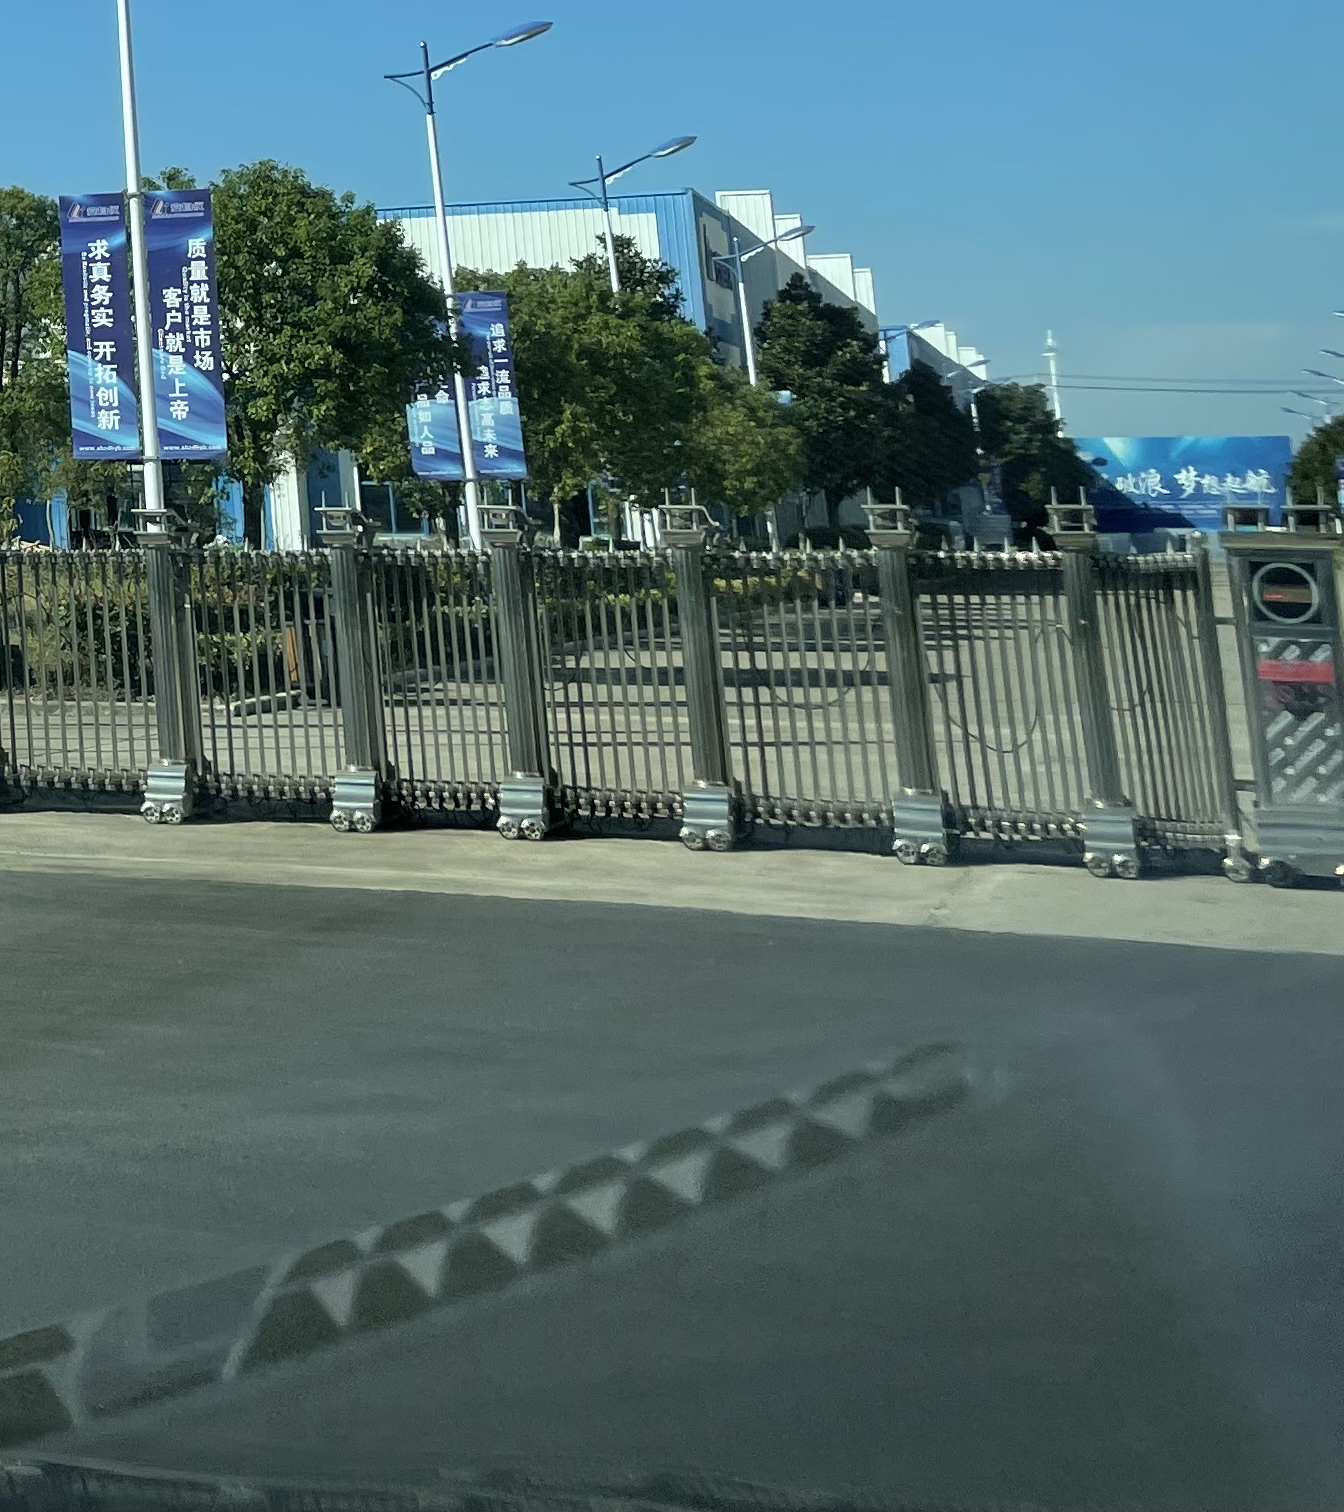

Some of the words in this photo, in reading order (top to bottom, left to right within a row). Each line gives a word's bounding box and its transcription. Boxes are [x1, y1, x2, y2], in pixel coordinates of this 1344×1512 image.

[87, 238, 115, 328] 求真务实
[187, 238, 214, 371] 质量就是市场
[93, 340, 121, 431] 开拓创新
[162, 287, 190, 420] 客户就是上帝
[489, 323, 514, 416] 追求一流品质
